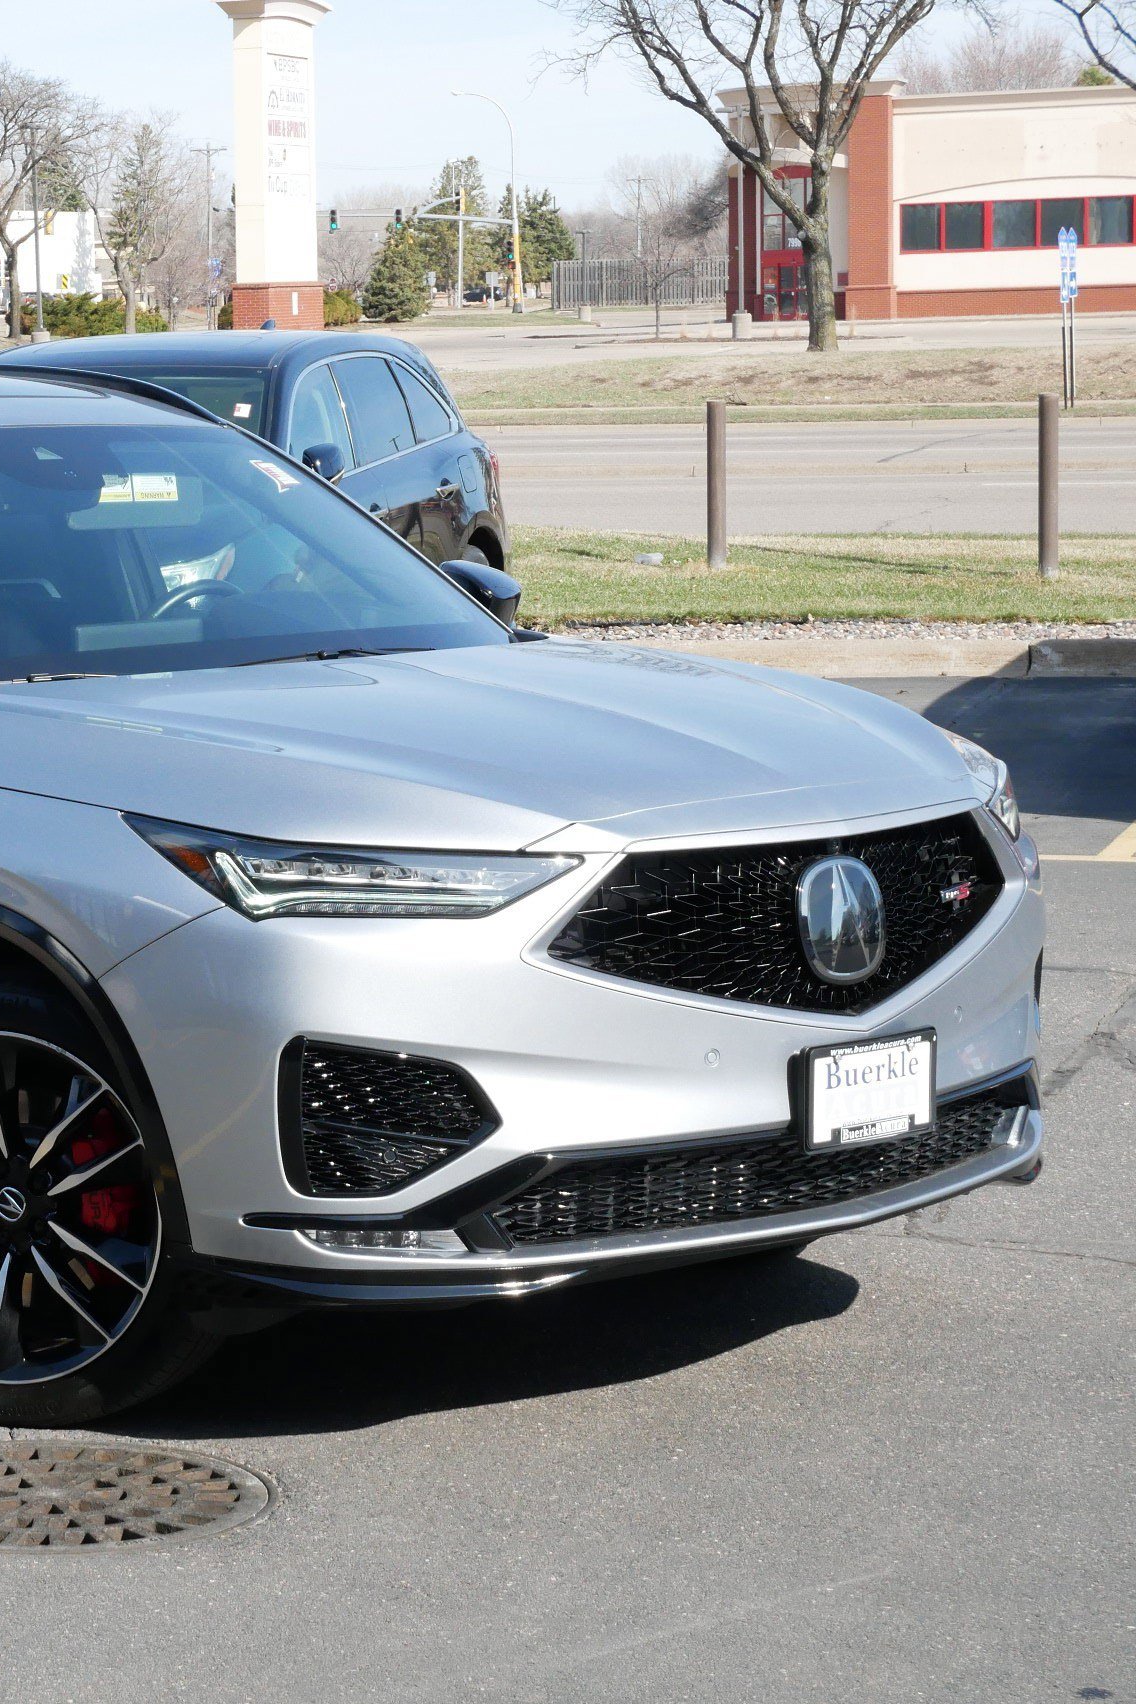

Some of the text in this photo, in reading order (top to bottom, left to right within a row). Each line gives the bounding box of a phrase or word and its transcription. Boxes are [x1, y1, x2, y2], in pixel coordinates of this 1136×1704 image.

[267, 119, 282, 136] WINE
[286, 120, 307, 138] SPIRITS
[830, 1035, 922, 1056] www.buerkleacura.com
[825, 1049, 919, 1090] Buerkle
